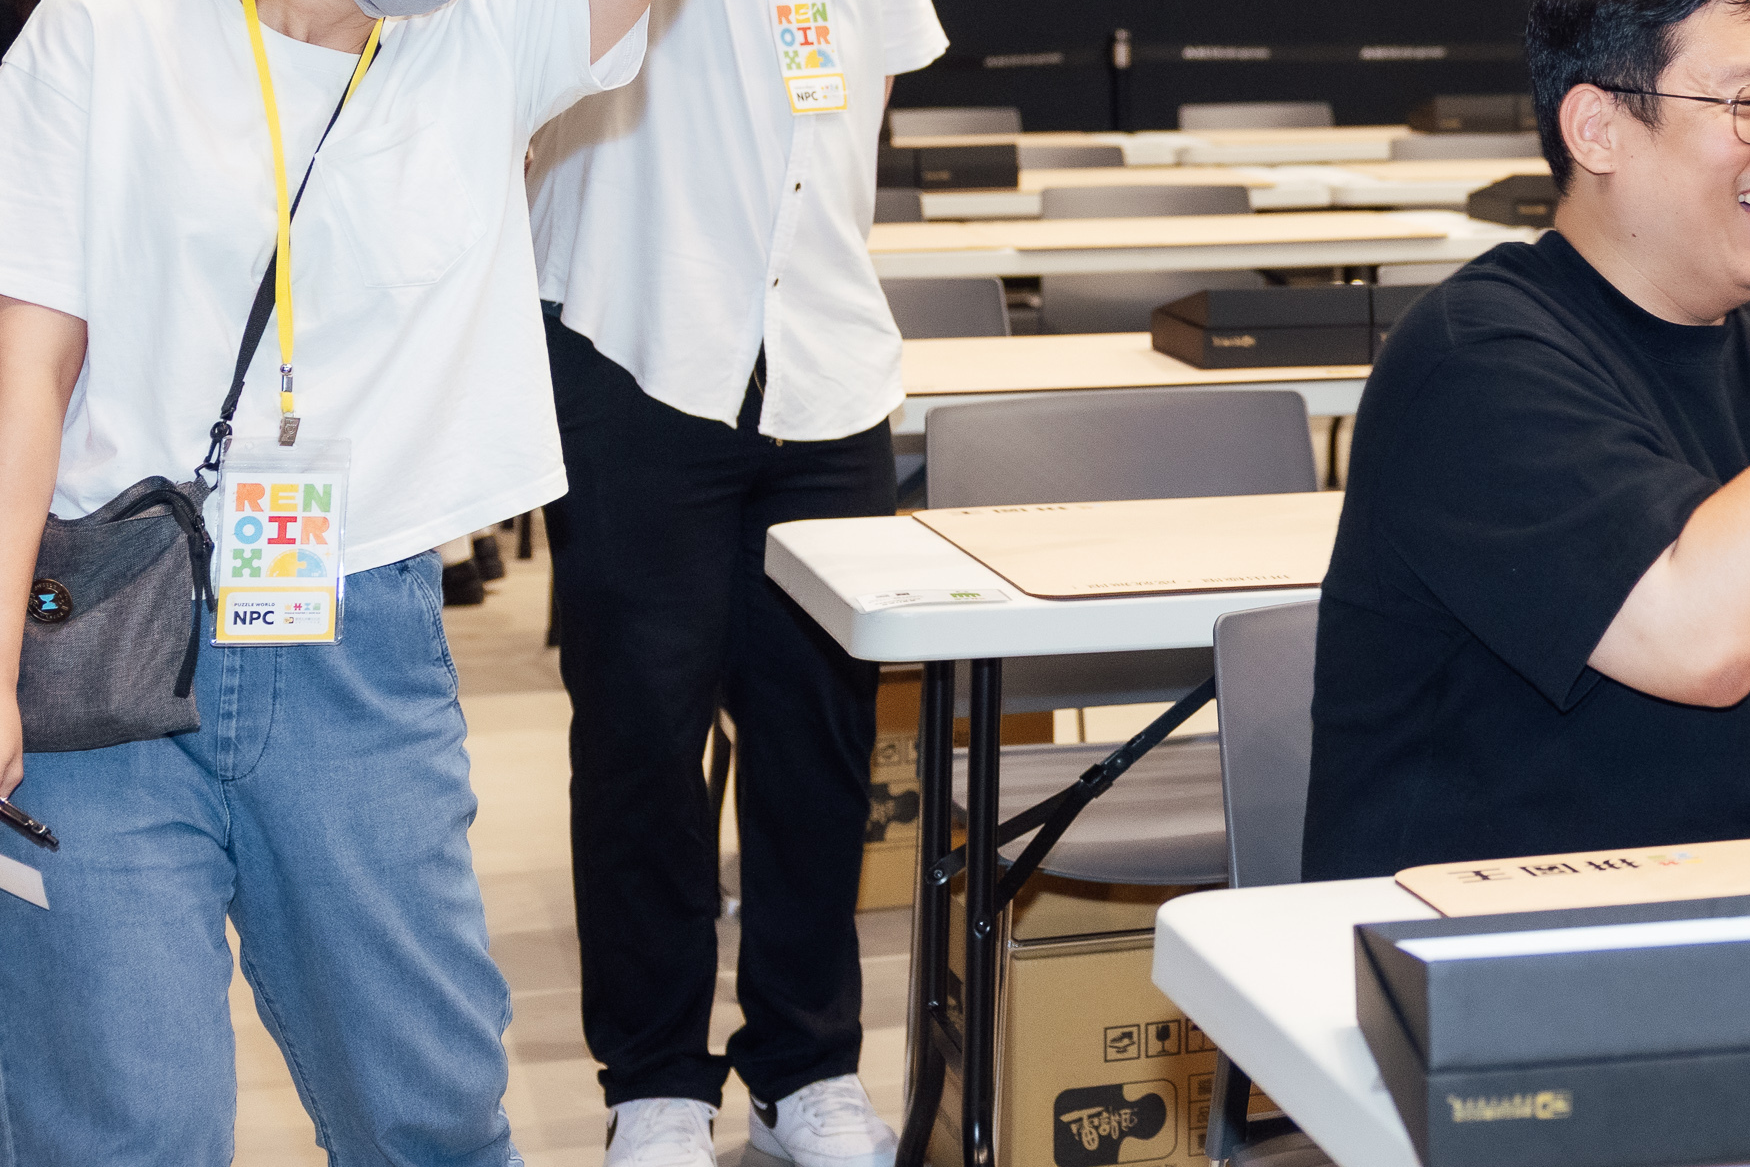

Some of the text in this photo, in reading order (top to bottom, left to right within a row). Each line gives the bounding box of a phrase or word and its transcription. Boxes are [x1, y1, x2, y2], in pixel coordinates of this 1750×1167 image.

[776, 2, 829, 25] REN
[780, 25, 830, 47] OIR
[796, 90, 818, 102] NPC
[235, 483, 332, 512] REN
[233, 515, 330, 545] OIR
[233, 610, 275, 625] NPC
